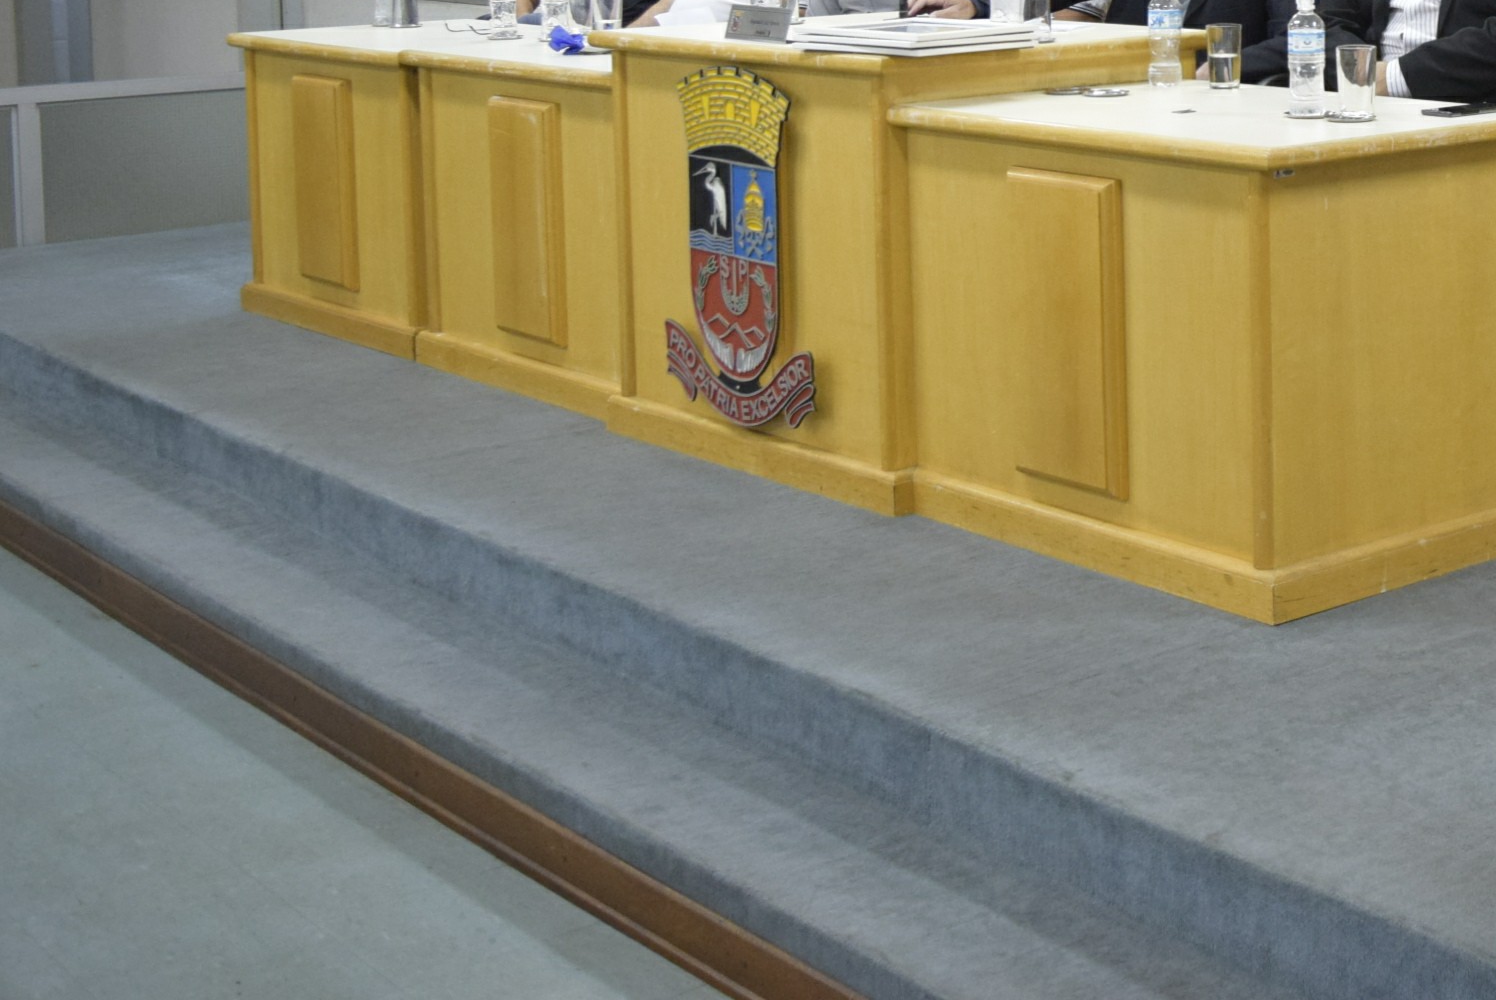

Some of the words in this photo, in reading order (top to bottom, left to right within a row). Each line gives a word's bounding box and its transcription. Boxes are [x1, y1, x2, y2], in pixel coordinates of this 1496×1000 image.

[669, 329, 697, 368] PRO
[694, 363, 739, 418] PATRIA
[741, 359, 809, 421] EXCELSIOR
